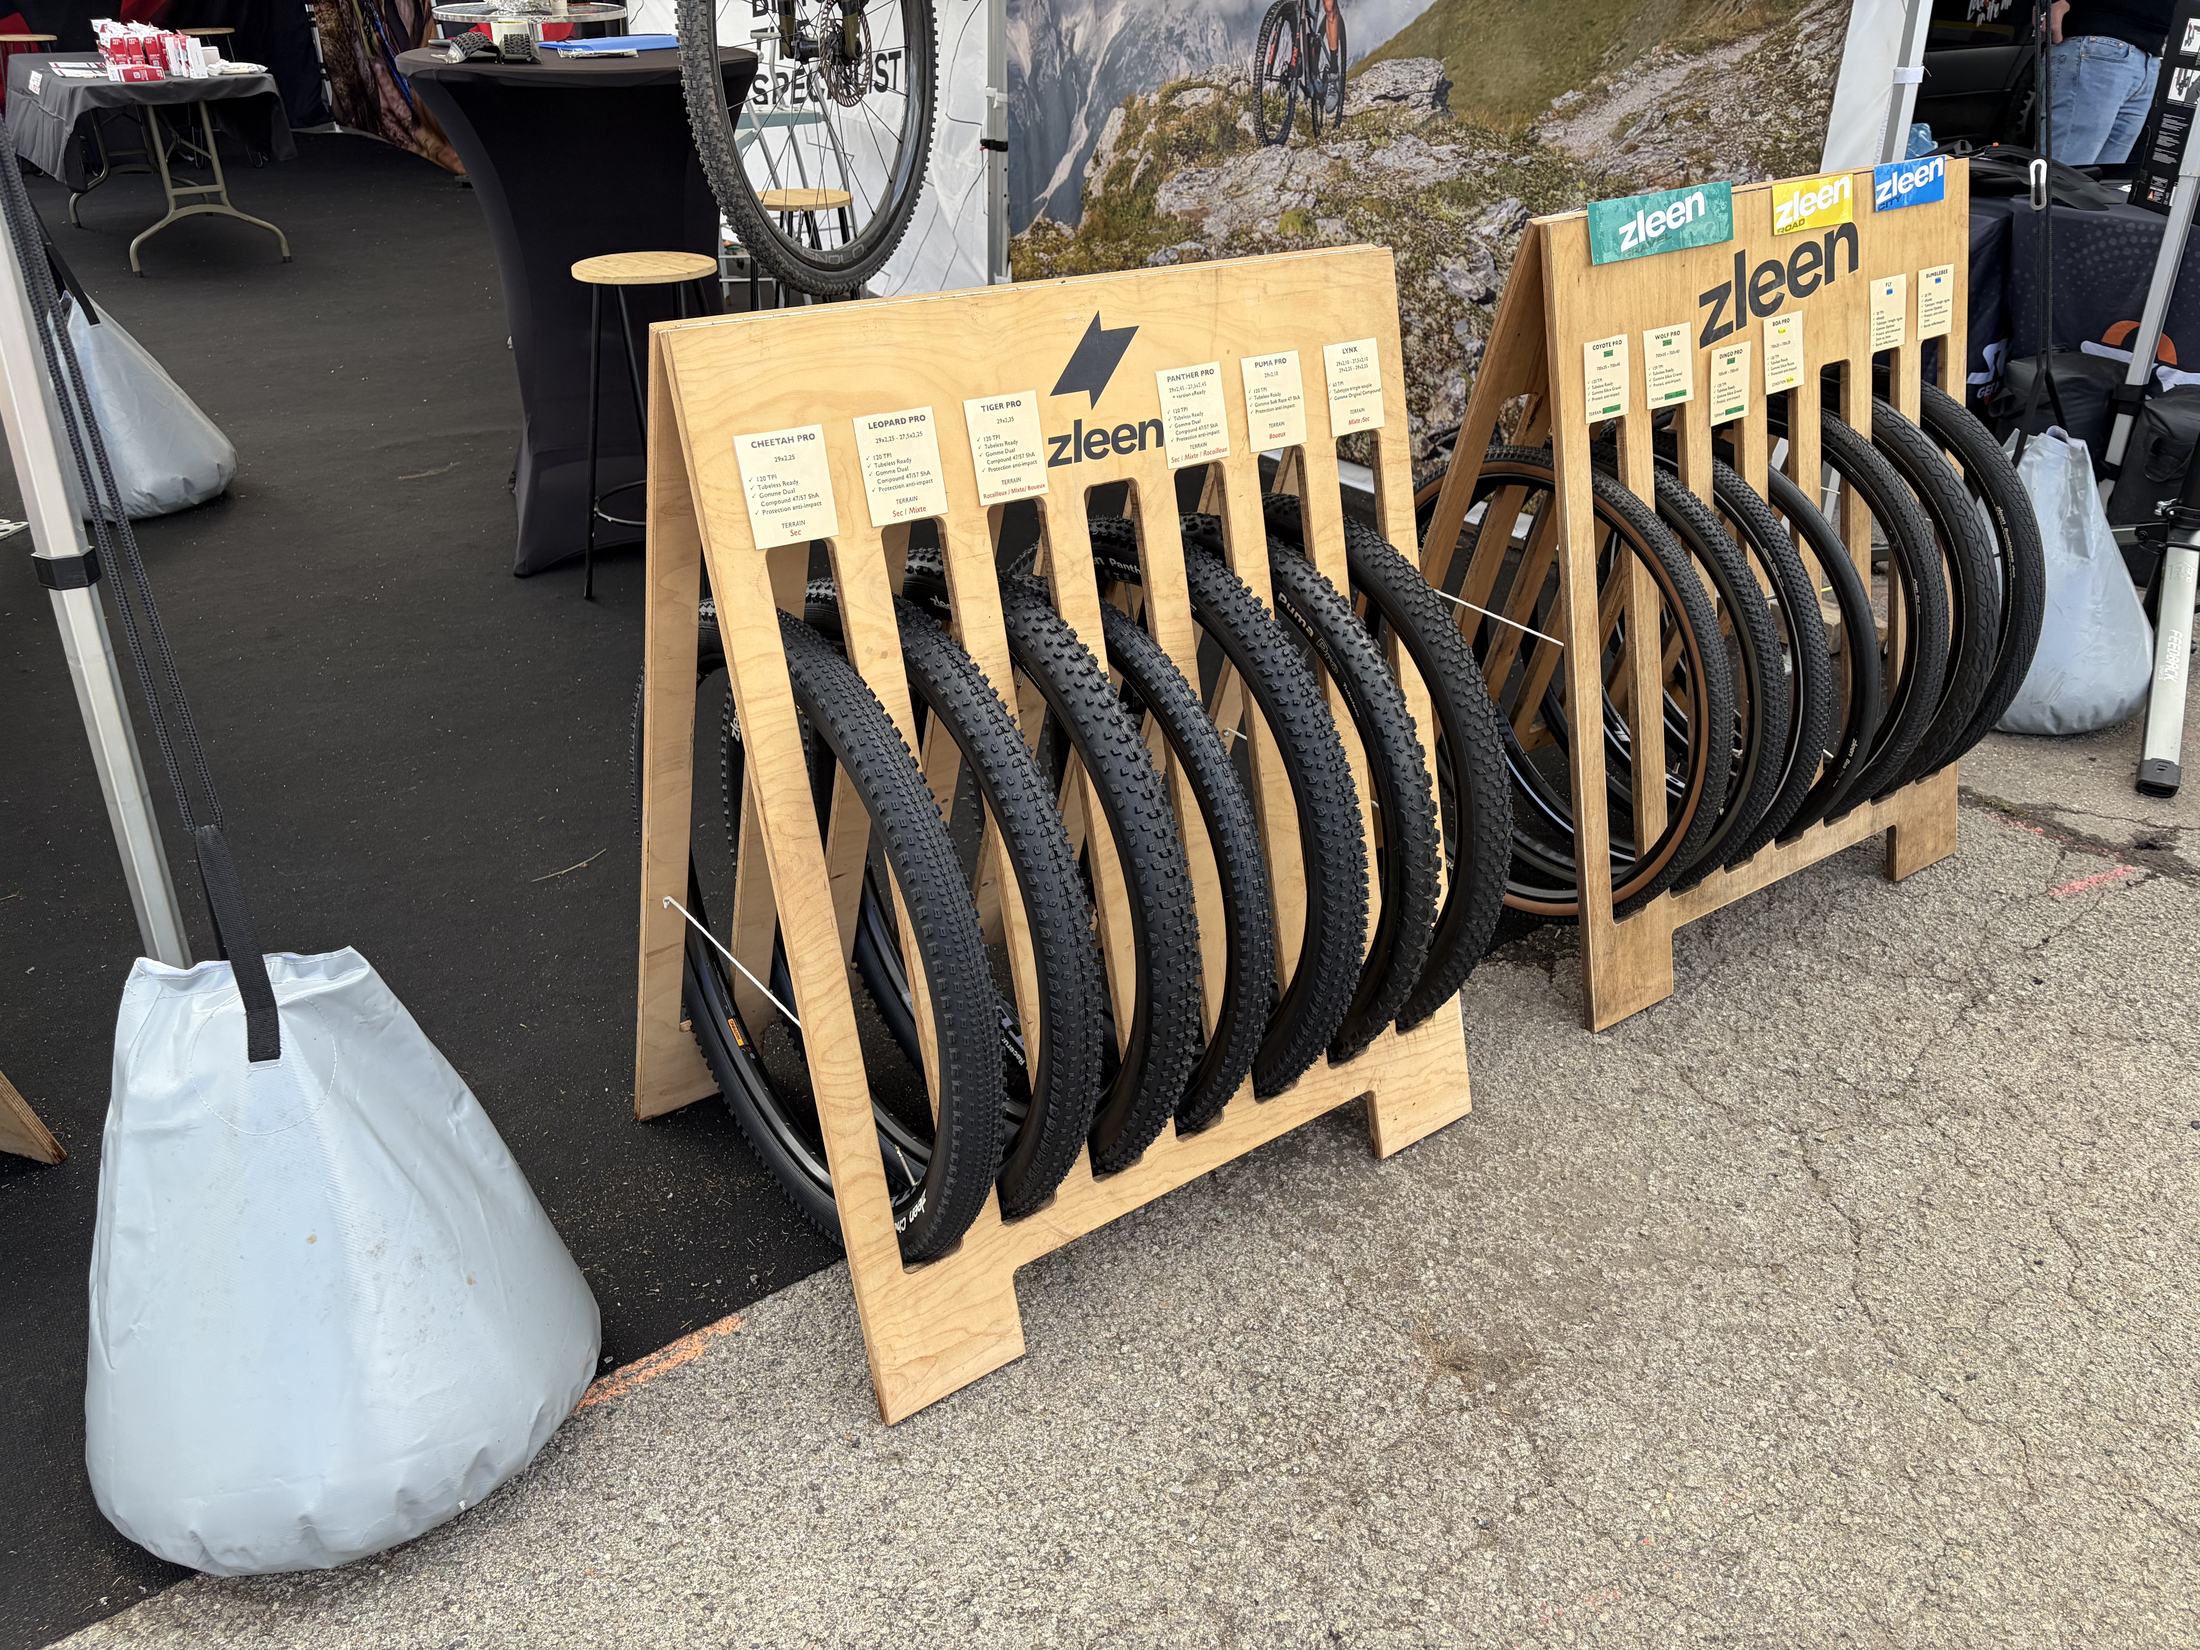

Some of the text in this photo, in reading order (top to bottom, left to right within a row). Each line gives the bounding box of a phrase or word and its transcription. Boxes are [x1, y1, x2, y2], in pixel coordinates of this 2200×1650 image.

[1876, 157, 1944, 204] zleen
[1776, 176, 1851, 228] zleen
[1619, 191, 1706, 252] zleen
[1777, 218, 1806, 234] ROAD
[1926, 269, 1948, 278] BUMBLEBEE
[1699, 222, 1859, 349] zleen
[1342, 346, 1358, 354] LYNX
[1592, 342, 1611, 350] COYOTE
[1719, 351, 1733, 359] DINGO
[1255, 360, 1273, 368] PUMA
[1167, 371, 1199, 382] PANTHER
[981, 400, 1022, 412] TIGER PRO
[868, 415, 926, 429] LEOPARD PRO
[1269, 421, 1285, 429] TERRAIN
[1176, 427, 1197, 435] Compound
[751, 433, 816, 448] CHEETAH PRO
[1048, 418, 1164, 468] zleen
[1203, 447, 1227, 456] Rocailleux
[987, 456, 1011, 465] Compound
[988, 460, 1038, 473] Protection anti-impact
[877, 475, 905, 485] Compound
[879, 479, 933, 492] Protection anti-impact
[1002, 477, 1022, 485] TERRAIN
[983, 490, 1007, 499] Rocailleux
[1028, 483, 1045, 491] Boueux
[761, 497, 791, 507] Compound
[896, 496, 918, 505] TERRAIN
[762, 501, 822, 515] Protection anti-impact
[909, 506, 926, 514] Mixte
[781, 520, 806, 529] TERRAIN
[790, 529, 801, 537] Sec
[1278, 592, 1314, 638] Puma
[1316, 638, 1339, 674] Pro
[2164, 629, 2183, 683] FEEDBACK
